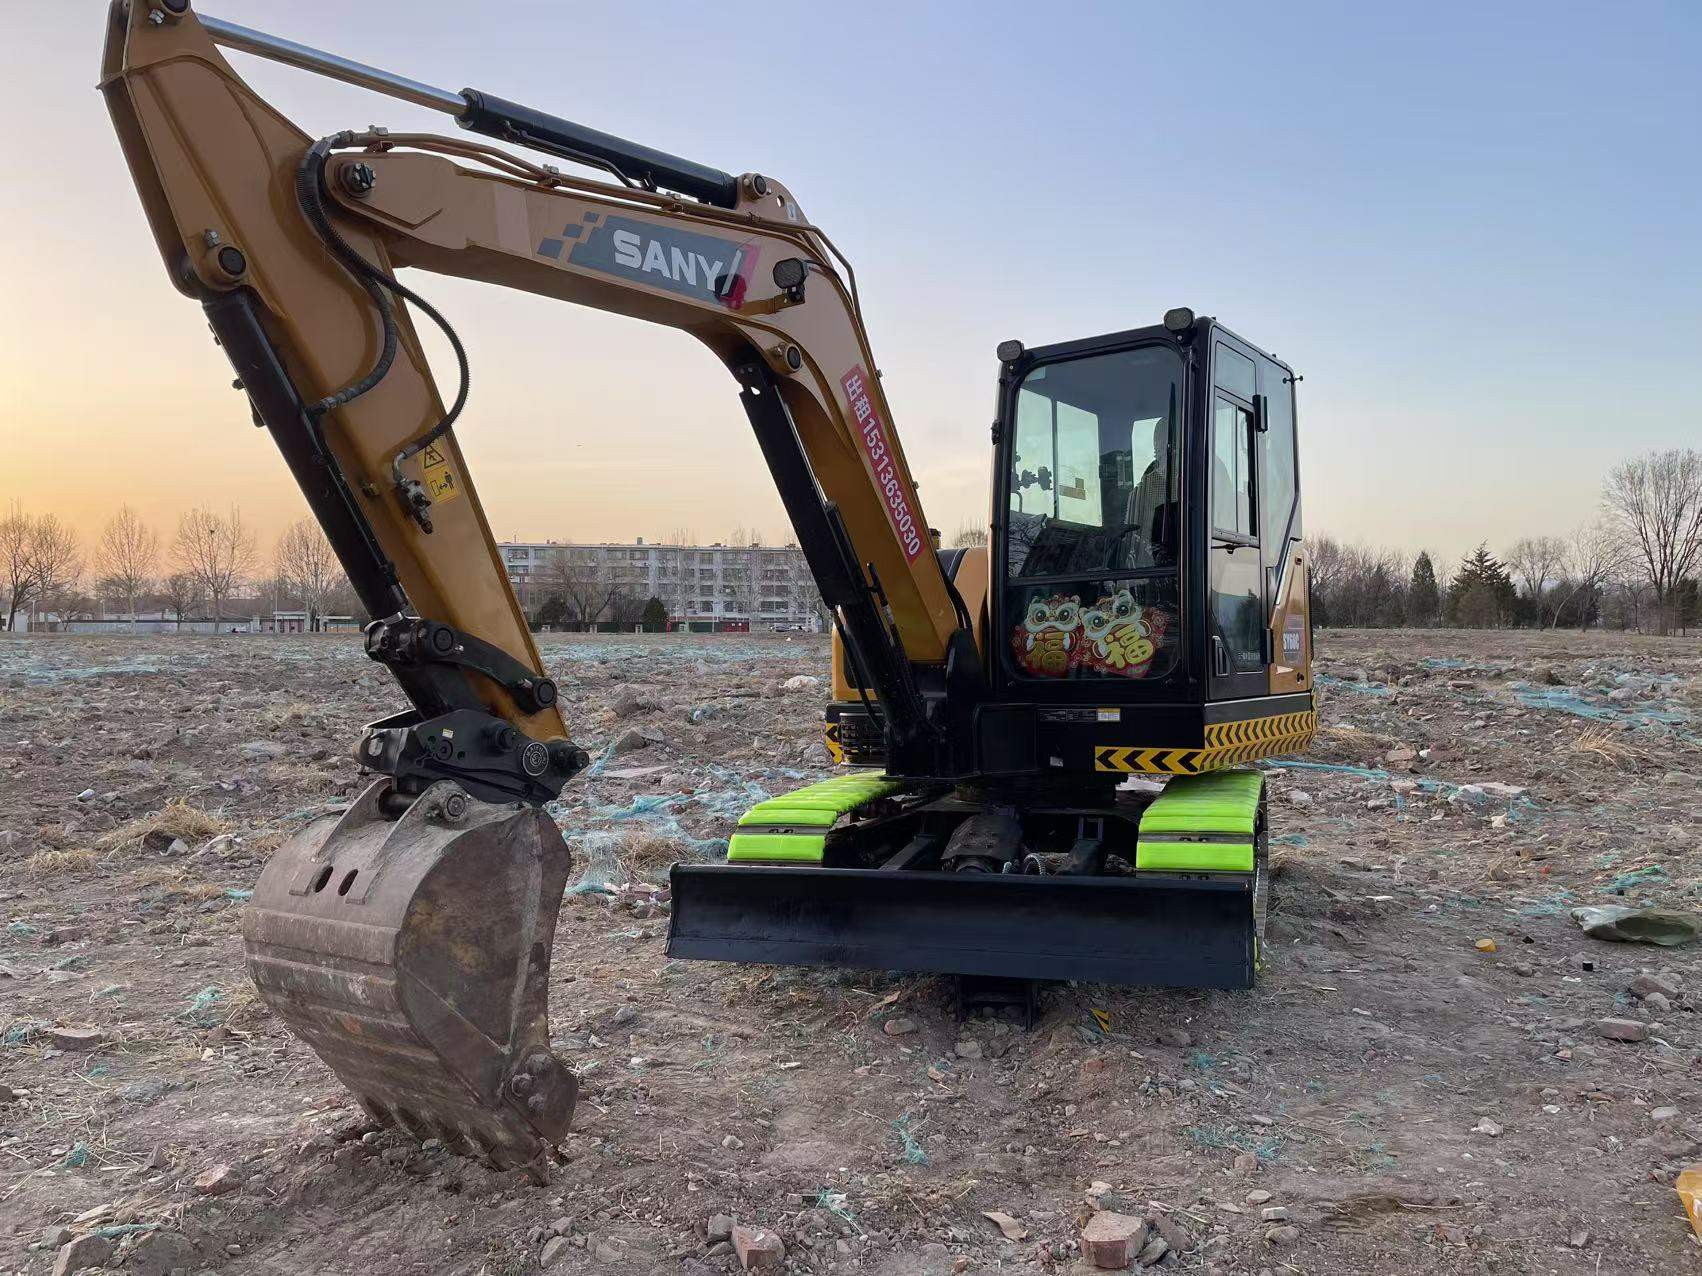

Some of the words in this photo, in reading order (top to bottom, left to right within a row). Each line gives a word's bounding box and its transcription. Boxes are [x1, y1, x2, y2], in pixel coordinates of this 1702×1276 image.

[613, 229, 723, 292] SANY
[1026, 631, 1069, 672] 福
[1105, 624, 1154, 669] 福
